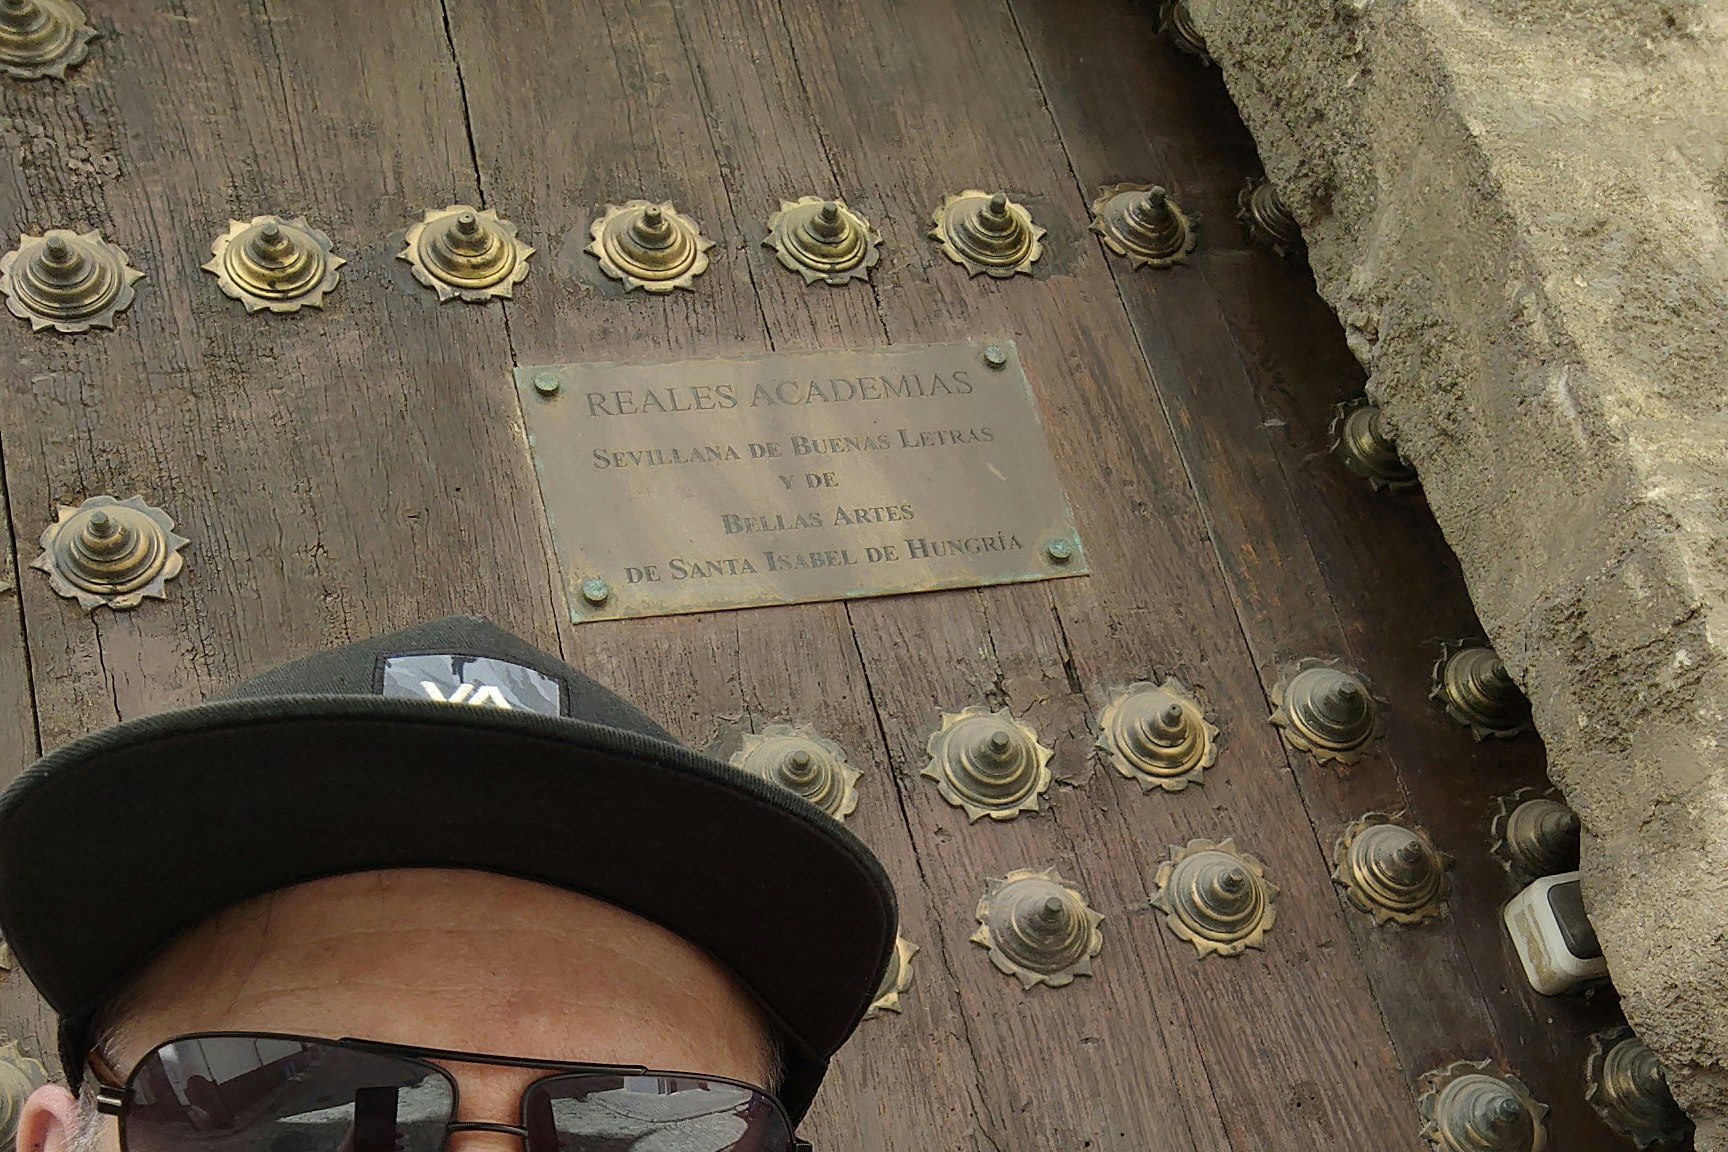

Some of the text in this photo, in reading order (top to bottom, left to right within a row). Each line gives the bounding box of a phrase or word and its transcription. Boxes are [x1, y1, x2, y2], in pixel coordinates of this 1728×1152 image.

[585, 370, 973, 417] REALES ACADEMIAS
[592, 426, 995, 469] SEVILLANA DE BUENAS LETRAS
[778, 471, 839, 490] Y DE
[720, 504, 915, 535] BELLAS ARTES
[623, 565, 661, 584] DE
[668, 558, 758, 580] SANTA
[762, 549, 858, 572] ISABEL
[864, 545, 900, 564] DE
